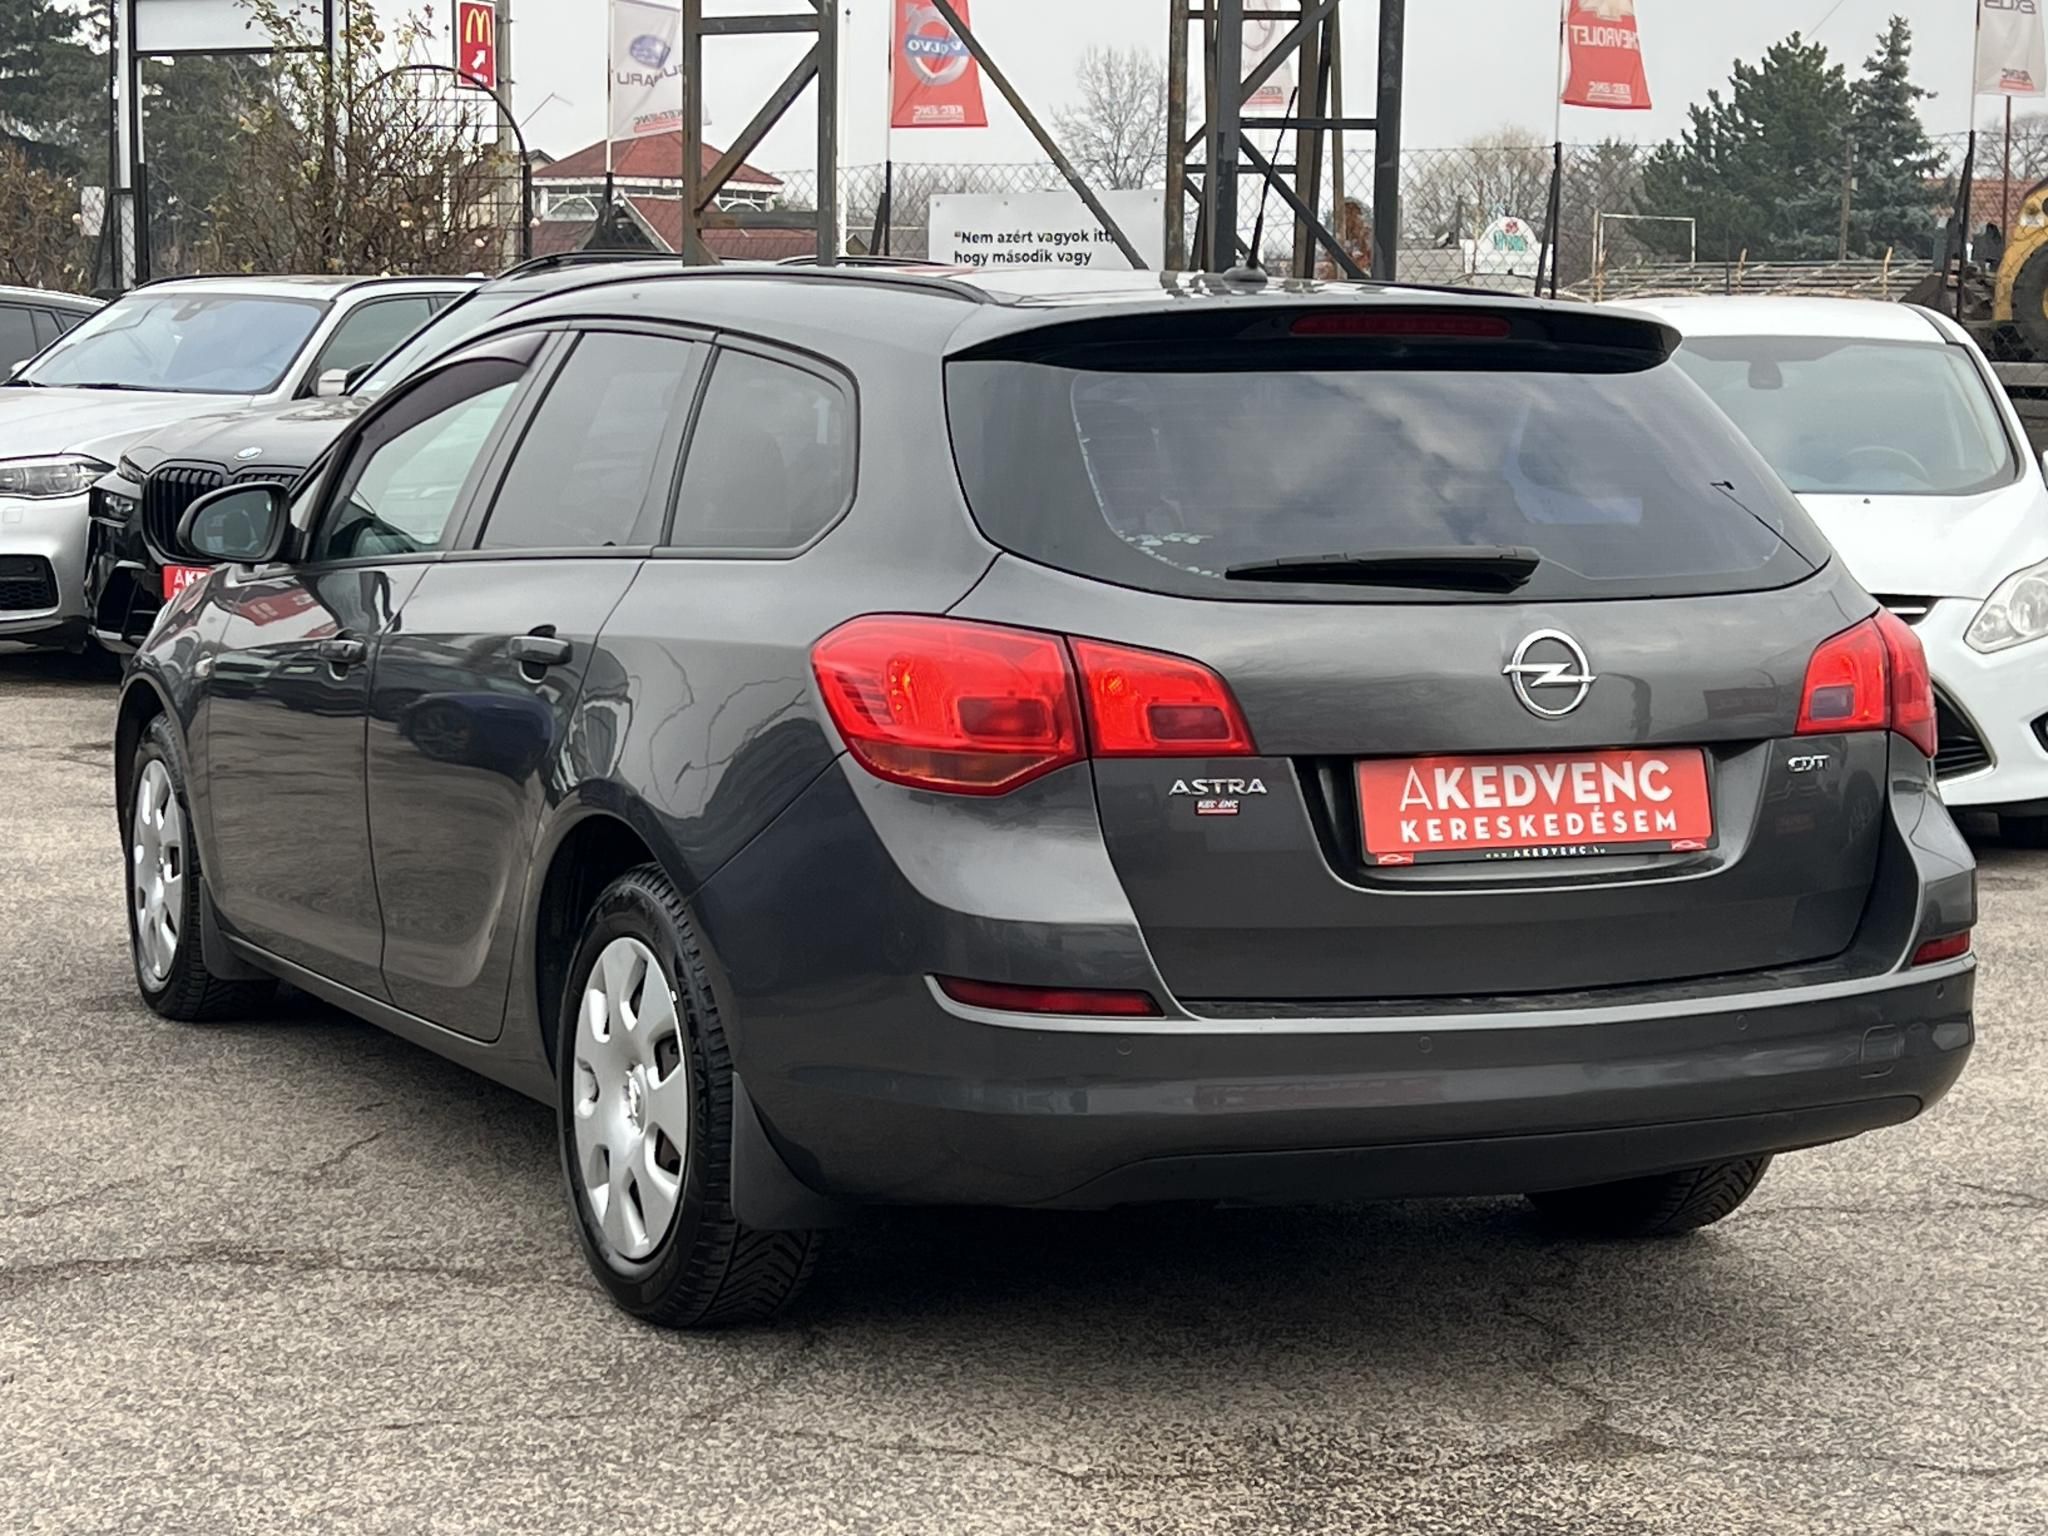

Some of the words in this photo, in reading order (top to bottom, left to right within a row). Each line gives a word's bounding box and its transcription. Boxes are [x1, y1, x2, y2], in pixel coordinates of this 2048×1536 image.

[997, 228, 1033, 243] azért
[1037, 229, 1089, 246] vagyok
[954, 250, 988, 266] hogy
[992, 249, 1053, 264] második
[1056, 251, 1092, 266] vagy
[1168, 778, 1268, 796] ASTRA
[1401, 804, 1678, 844] KERESKEDÉSEM
